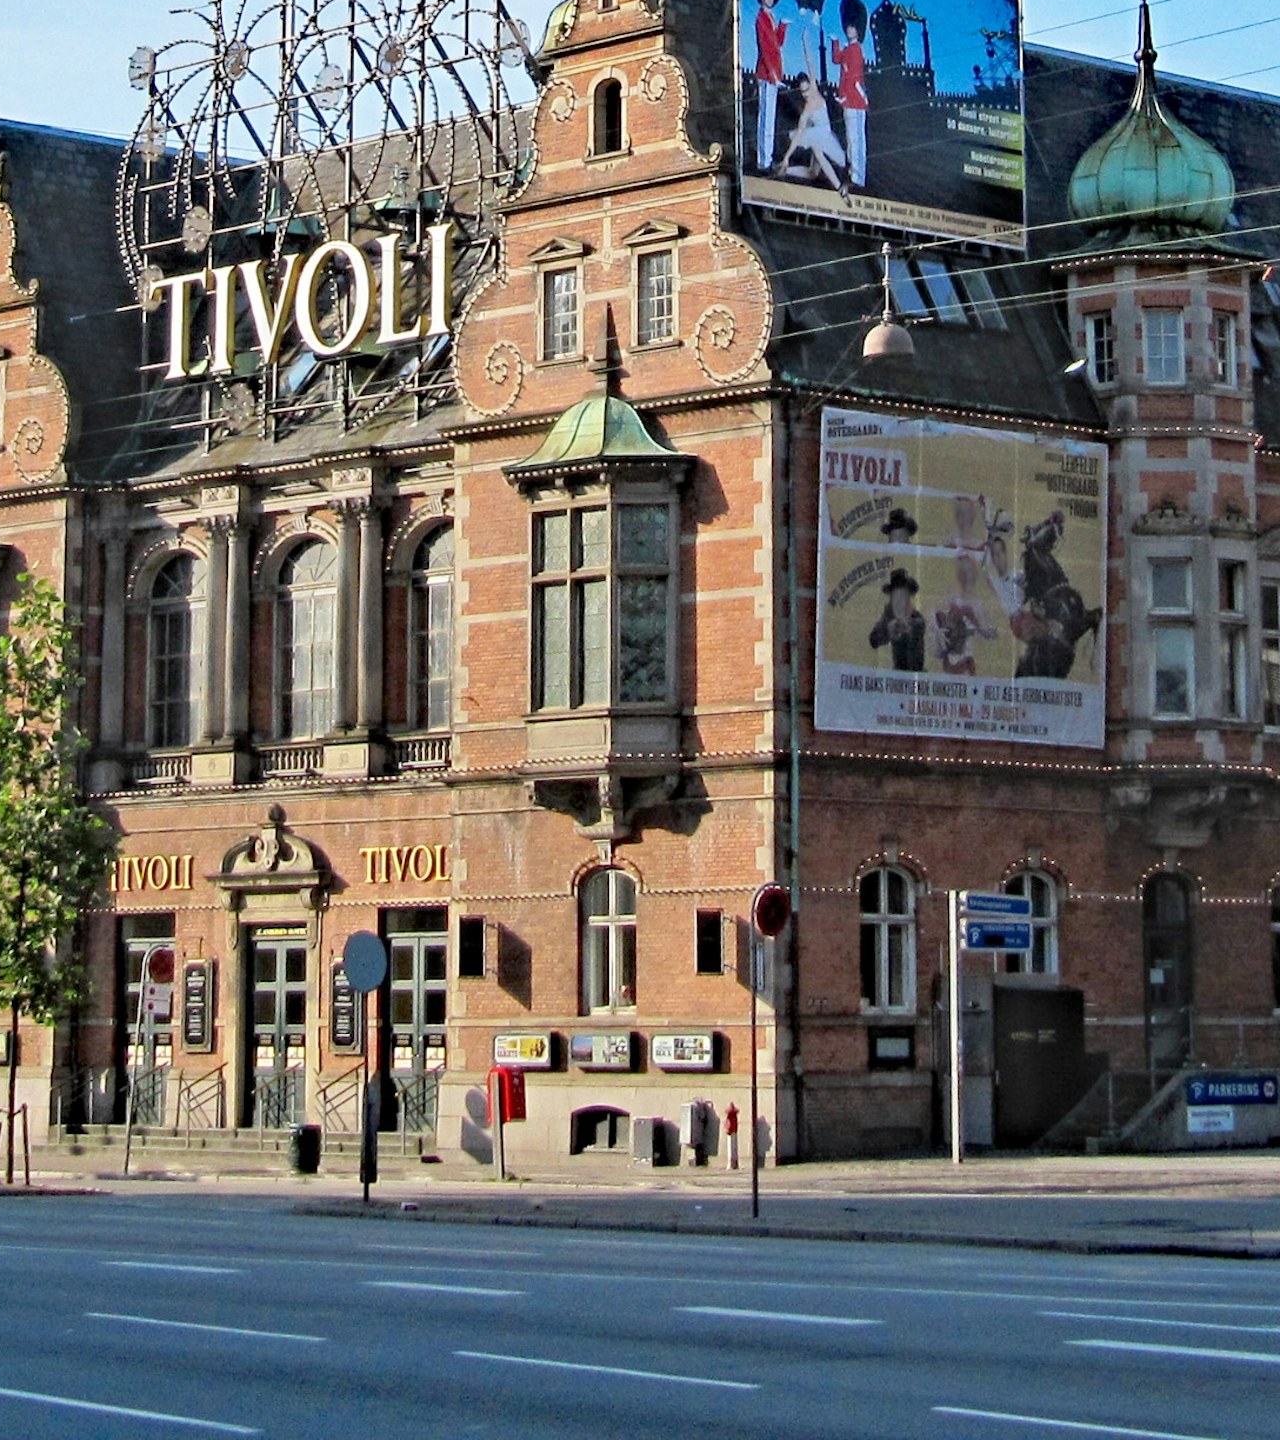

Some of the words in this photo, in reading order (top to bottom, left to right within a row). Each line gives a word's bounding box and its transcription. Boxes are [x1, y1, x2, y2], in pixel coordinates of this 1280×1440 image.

[149, 222, 456, 380] TIVOLI
[826, 451, 901, 486] TIVOLI
[359, 844, 453, 883] TIVOL
[1208, 1082, 1260, 1097] PARKERING
